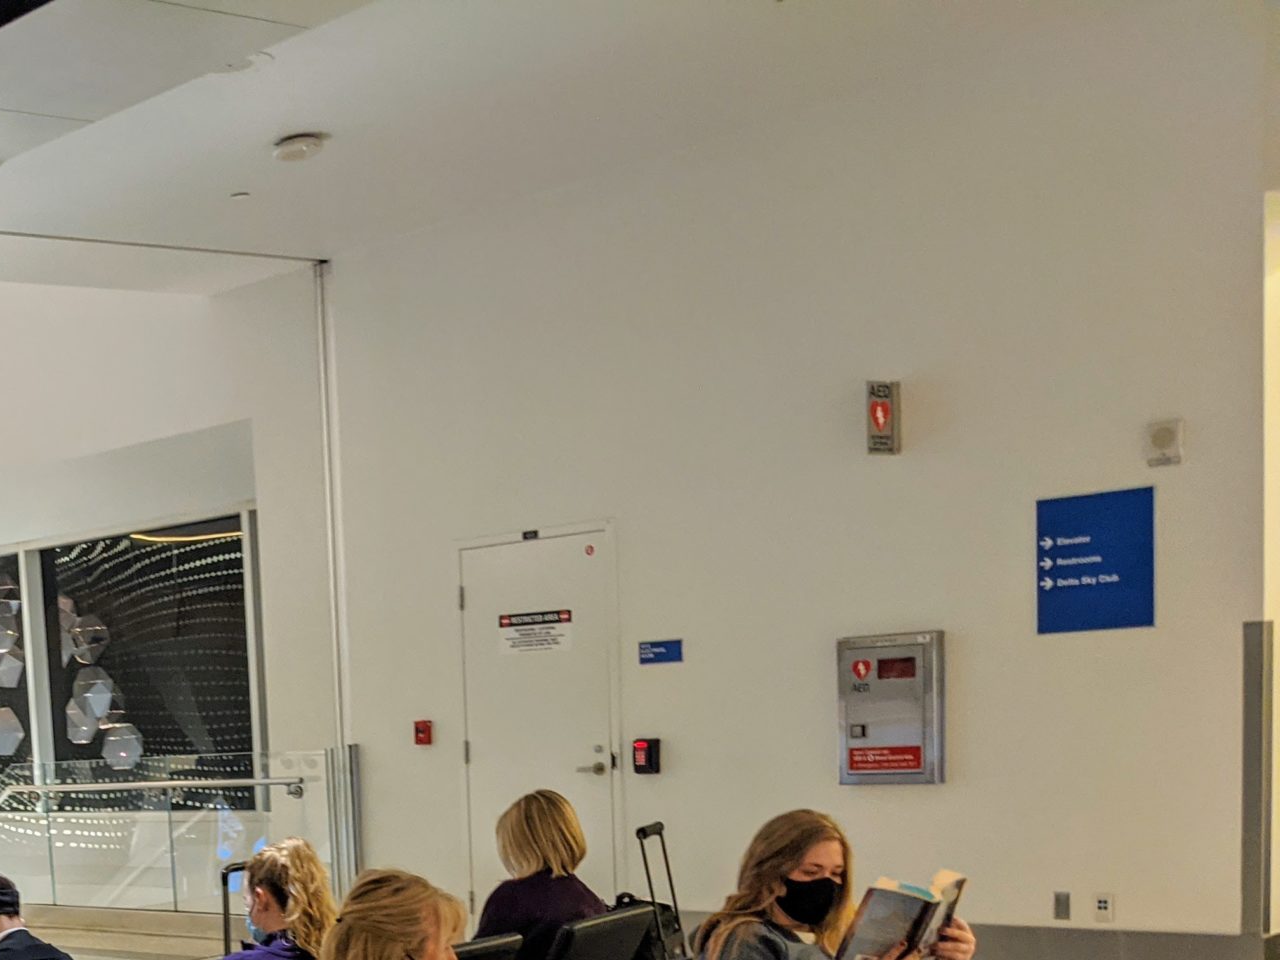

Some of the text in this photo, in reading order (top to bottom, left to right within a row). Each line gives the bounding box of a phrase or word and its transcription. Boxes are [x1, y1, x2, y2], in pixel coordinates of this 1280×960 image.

[1056, 536, 1091, 546] Elevator
[1056, 555, 1102, 566] Restrooms
[1056, 573, 1120, 587] Delta Sky Club
